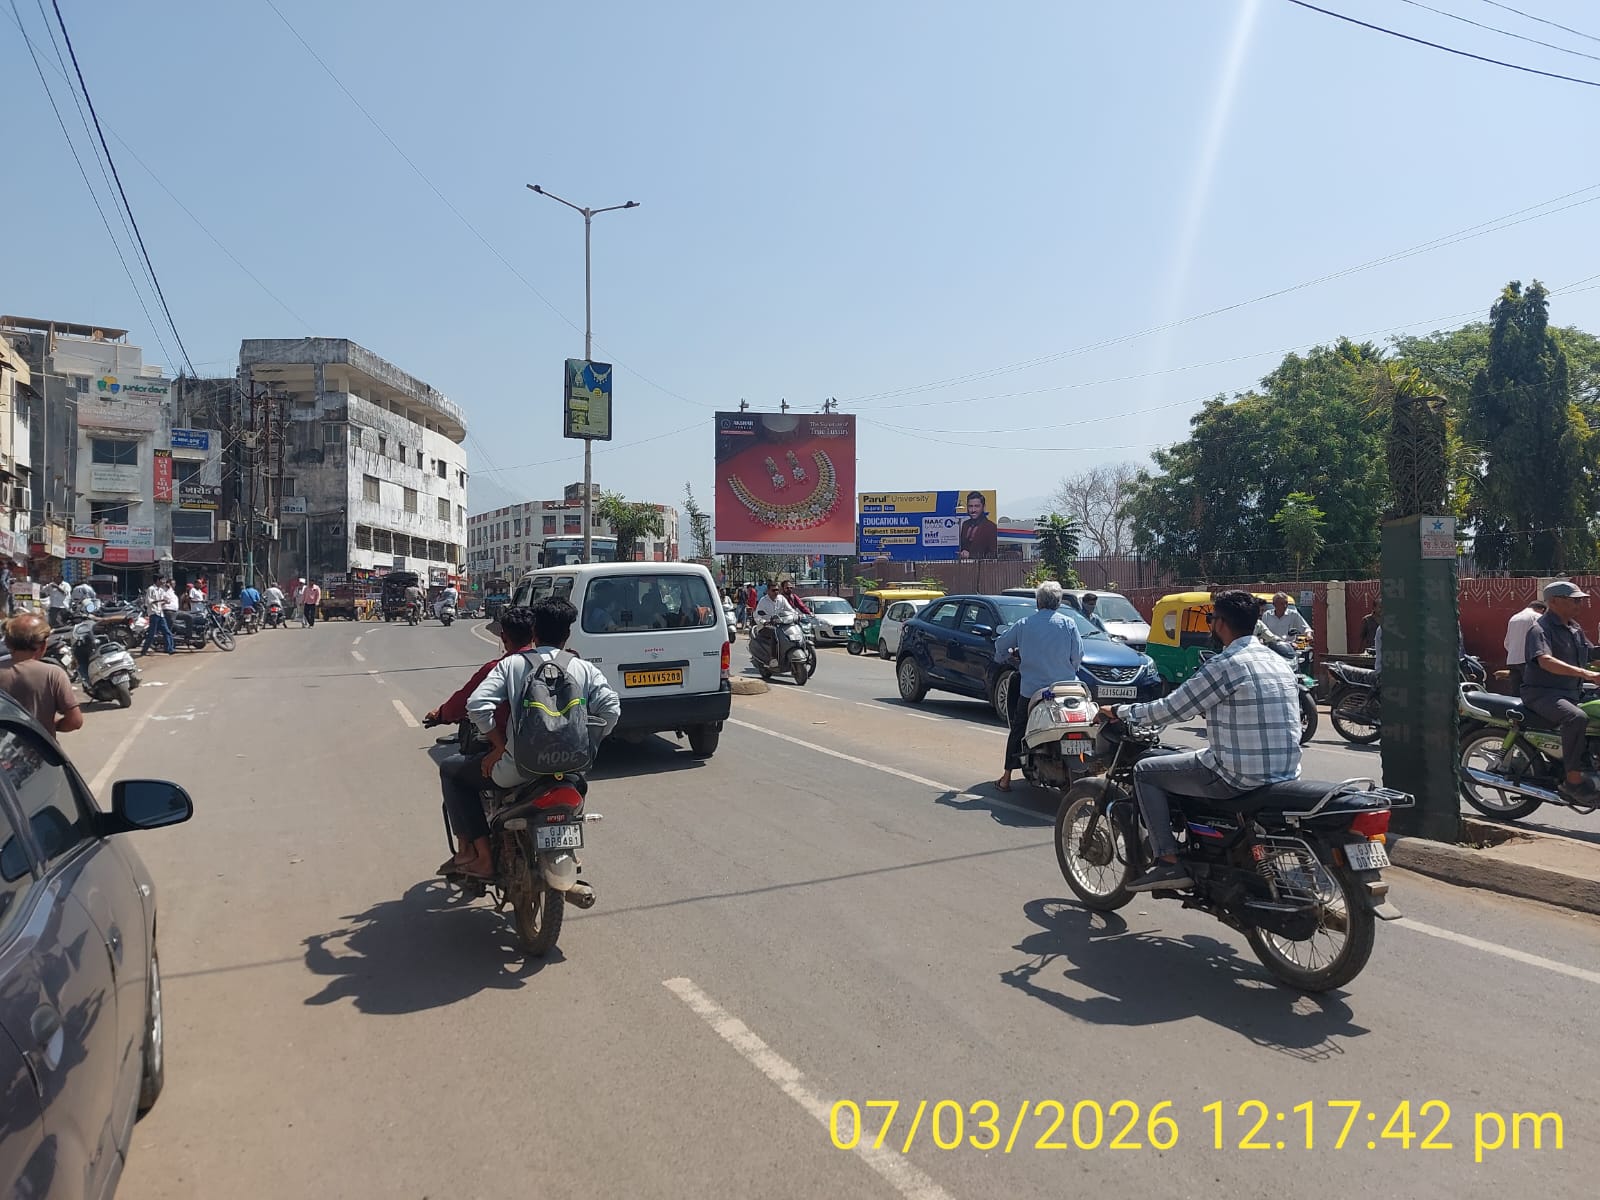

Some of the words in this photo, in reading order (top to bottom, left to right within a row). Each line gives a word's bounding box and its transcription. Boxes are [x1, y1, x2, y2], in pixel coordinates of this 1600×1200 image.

[863, 495, 886, 503] Parul
[891, 495, 929, 503] University
[863, 517, 899, 526] EDUCATION
[900, 517, 909, 525] KA
